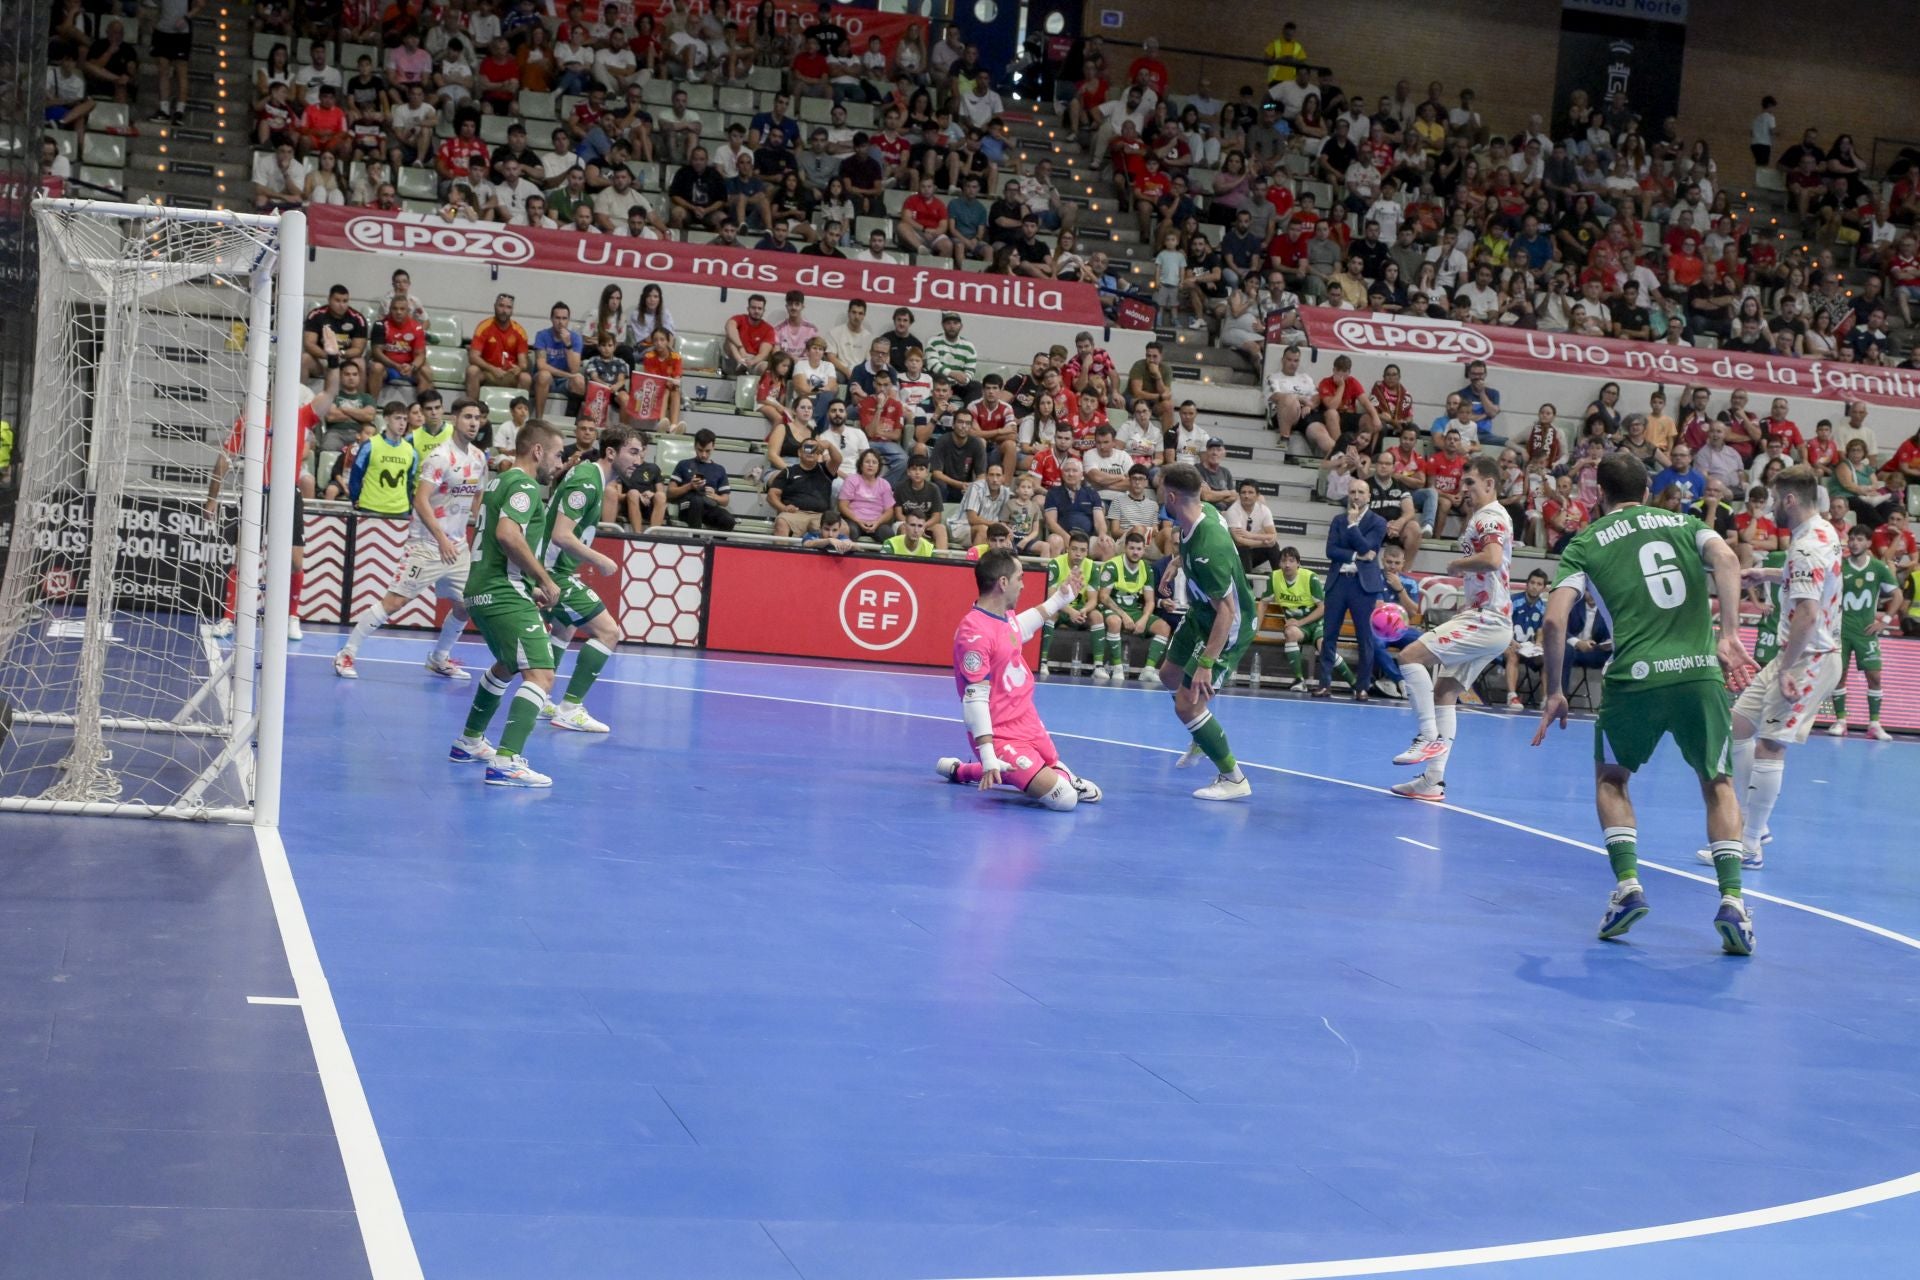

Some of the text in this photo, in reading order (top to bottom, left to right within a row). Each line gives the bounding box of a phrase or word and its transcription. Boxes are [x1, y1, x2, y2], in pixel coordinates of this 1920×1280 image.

[576, 238, 1064, 312] Uno más de la familia
[1525, 331, 1610, 366] Uno
[1625, 349, 1699, 375] más
[1711, 356, 1755, 381] de
[1766, 360, 1798, 386] la
[1595, 512, 1689, 547] RAÚL GÓMEZ
[408, 565, 422, 579] 51
[1638, 540, 1688, 610] 6
[859, 588, 902, 608] RF
[857, 612, 900, 631] EF
[1759, 631, 1776, 647] 20
[1652, 655, 1695, 674] TORREJÓN
